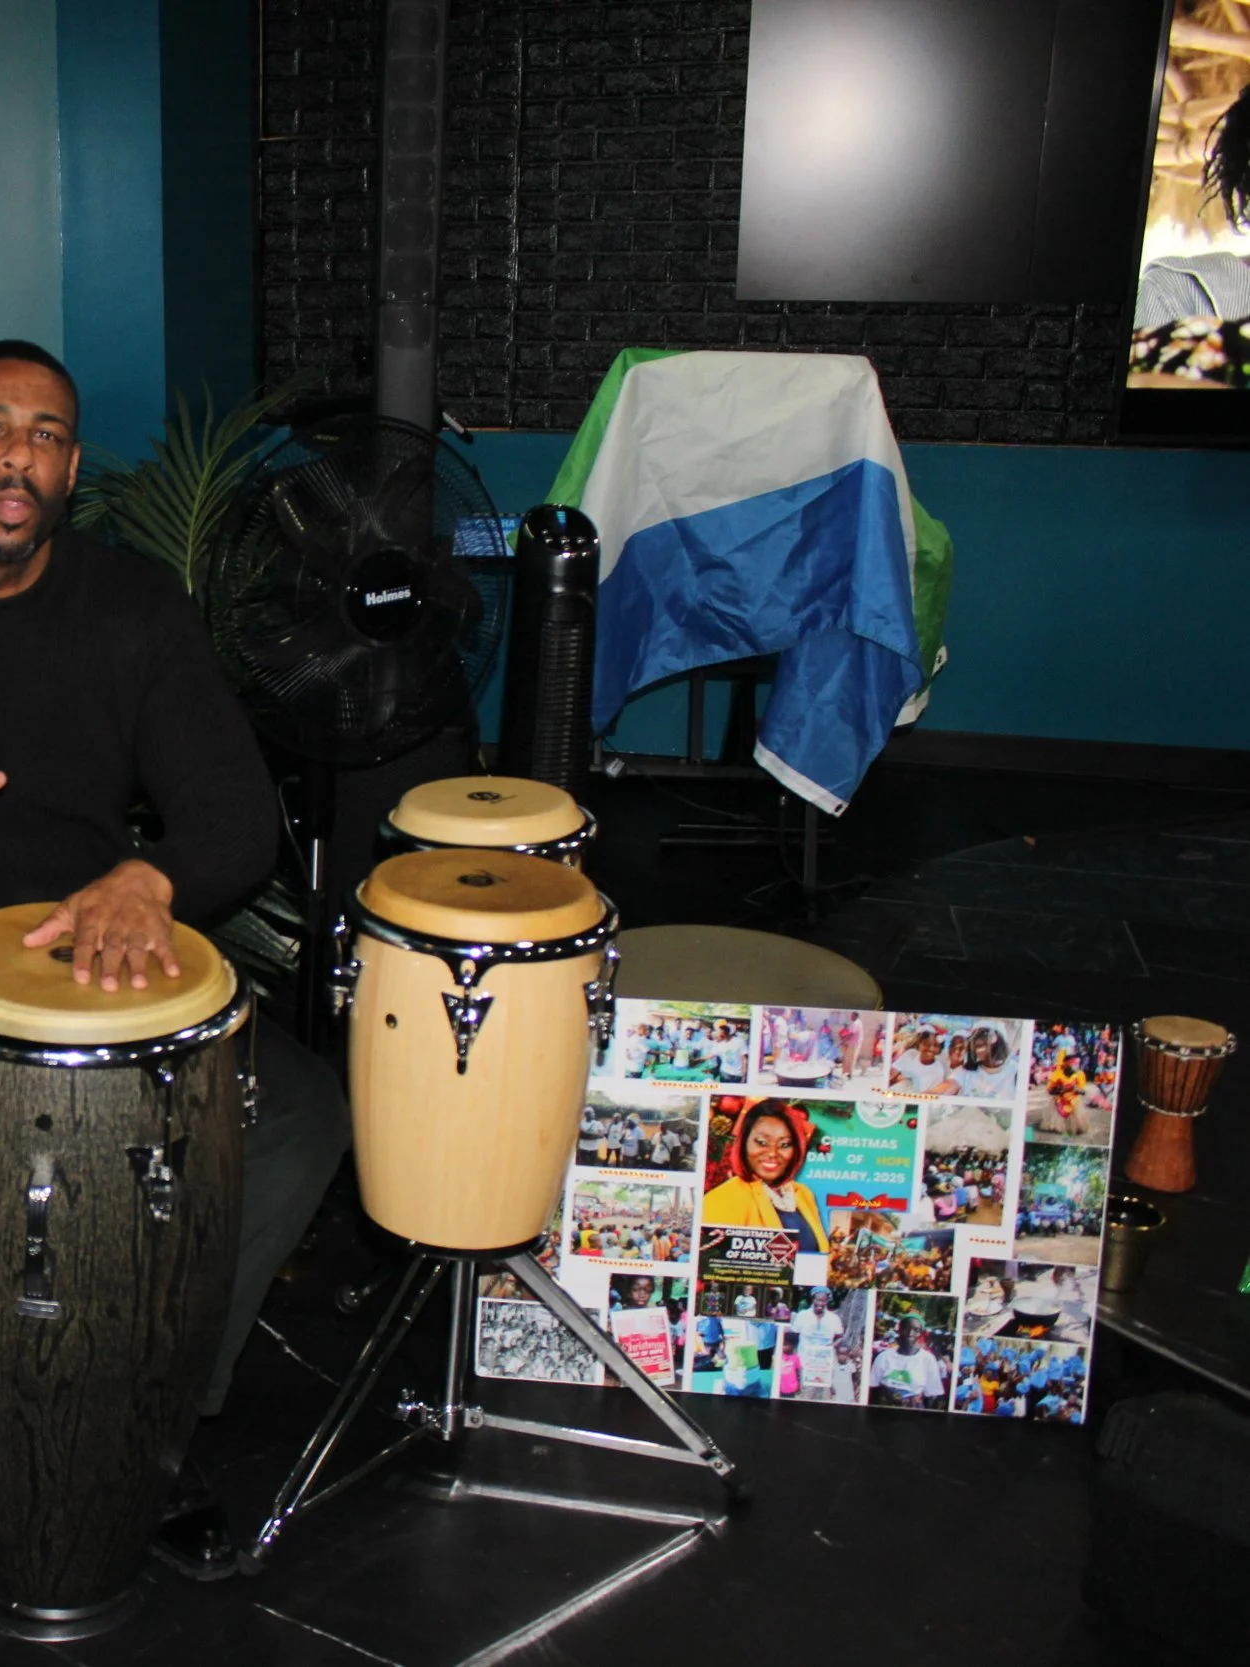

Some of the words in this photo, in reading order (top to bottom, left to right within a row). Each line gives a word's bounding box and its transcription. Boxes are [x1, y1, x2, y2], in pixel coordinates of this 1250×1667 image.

[365, 589, 411, 606] Holmes
[821, 1135, 898, 1149] CHRISTMAS
[806, 1152, 834, 1163] DAY
[846, 1154, 864, 1164] OF
[876, 1156, 910, 1167] HOPE
[807, 1169, 870, 1184] JANUARY,
[873, 1172, 906, 1184] 2025
[725, 1229, 775, 1239] CHRISTMAS
[732, 1237, 766, 1250] DAY
[726, 1250, 739, 1259] OF
[741, 1251, 768, 1260] HOPE
